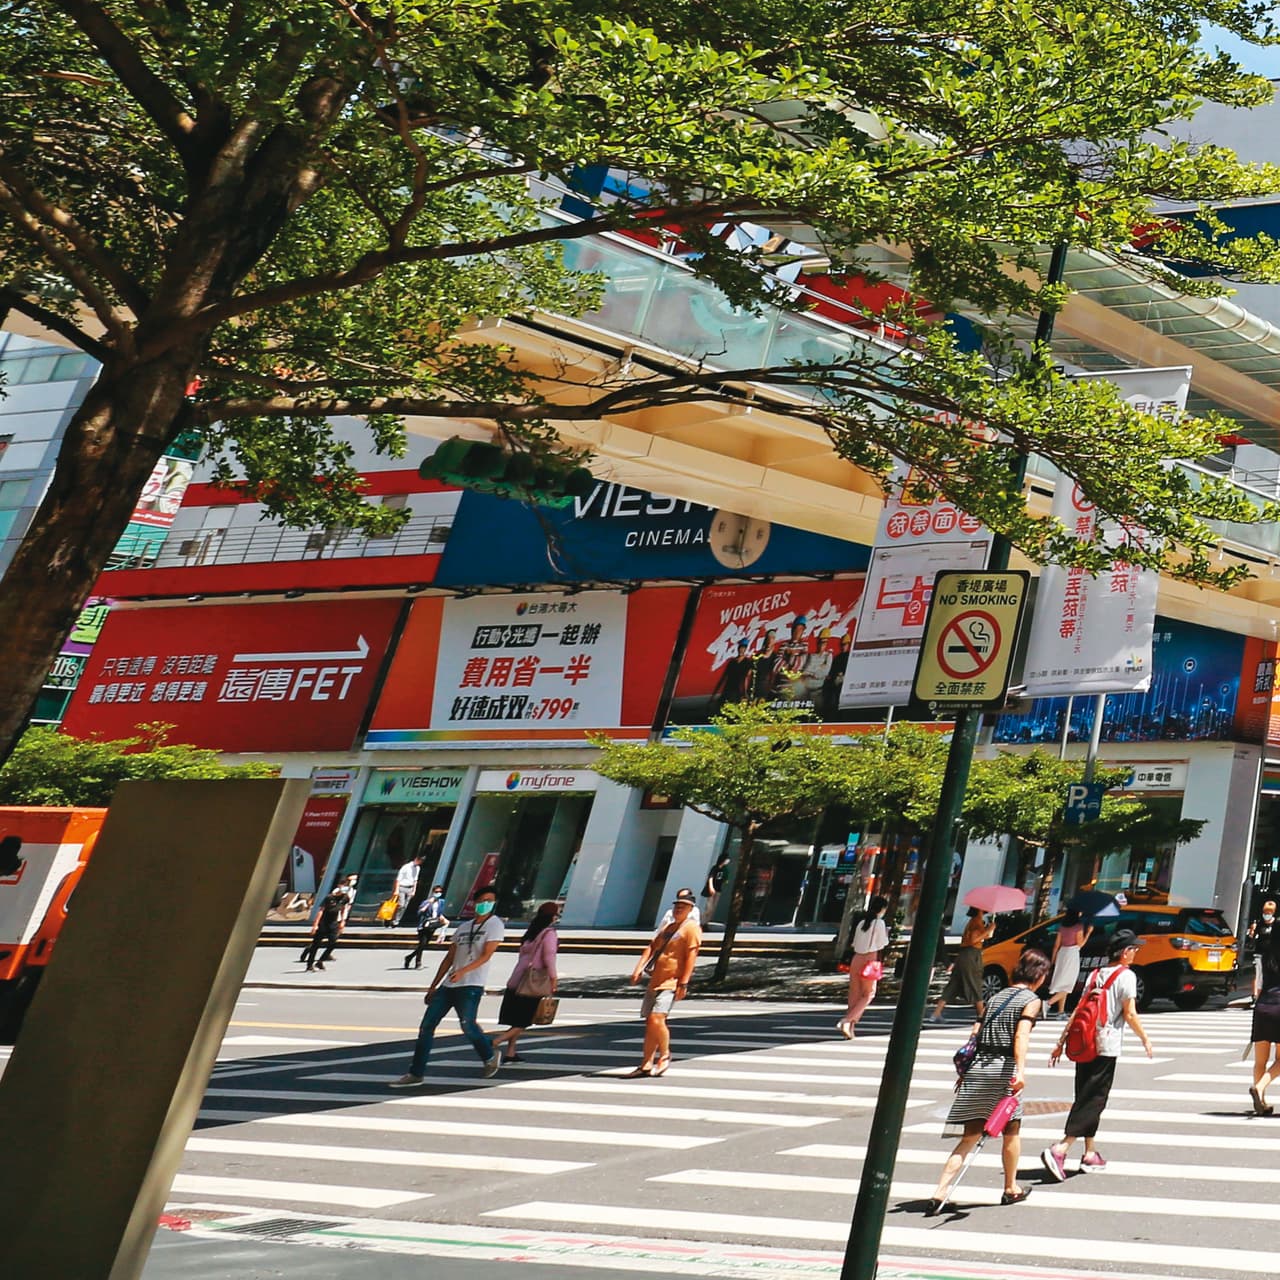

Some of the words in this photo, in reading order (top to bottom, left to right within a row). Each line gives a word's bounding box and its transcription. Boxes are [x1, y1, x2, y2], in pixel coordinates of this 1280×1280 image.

[625, 528, 712, 547] CINEMA
[720, 590, 792, 625] WORKERS
[940, 594, 958, 605] NO
[960, 594, 1018, 606] SMOKING
[99, 656, 158, 677] 只有遠傳
[160, 654, 219, 675] 沒有距離
[459, 654, 592, 688] 費用省一半
[531, 697, 574, 720] $799
[400, 775, 463, 788] VIESHOW
[519, 775, 576, 790] myfone
[1137, 772, 1173, 782] 中華電信
[1068, 785, 1089, 808] P
